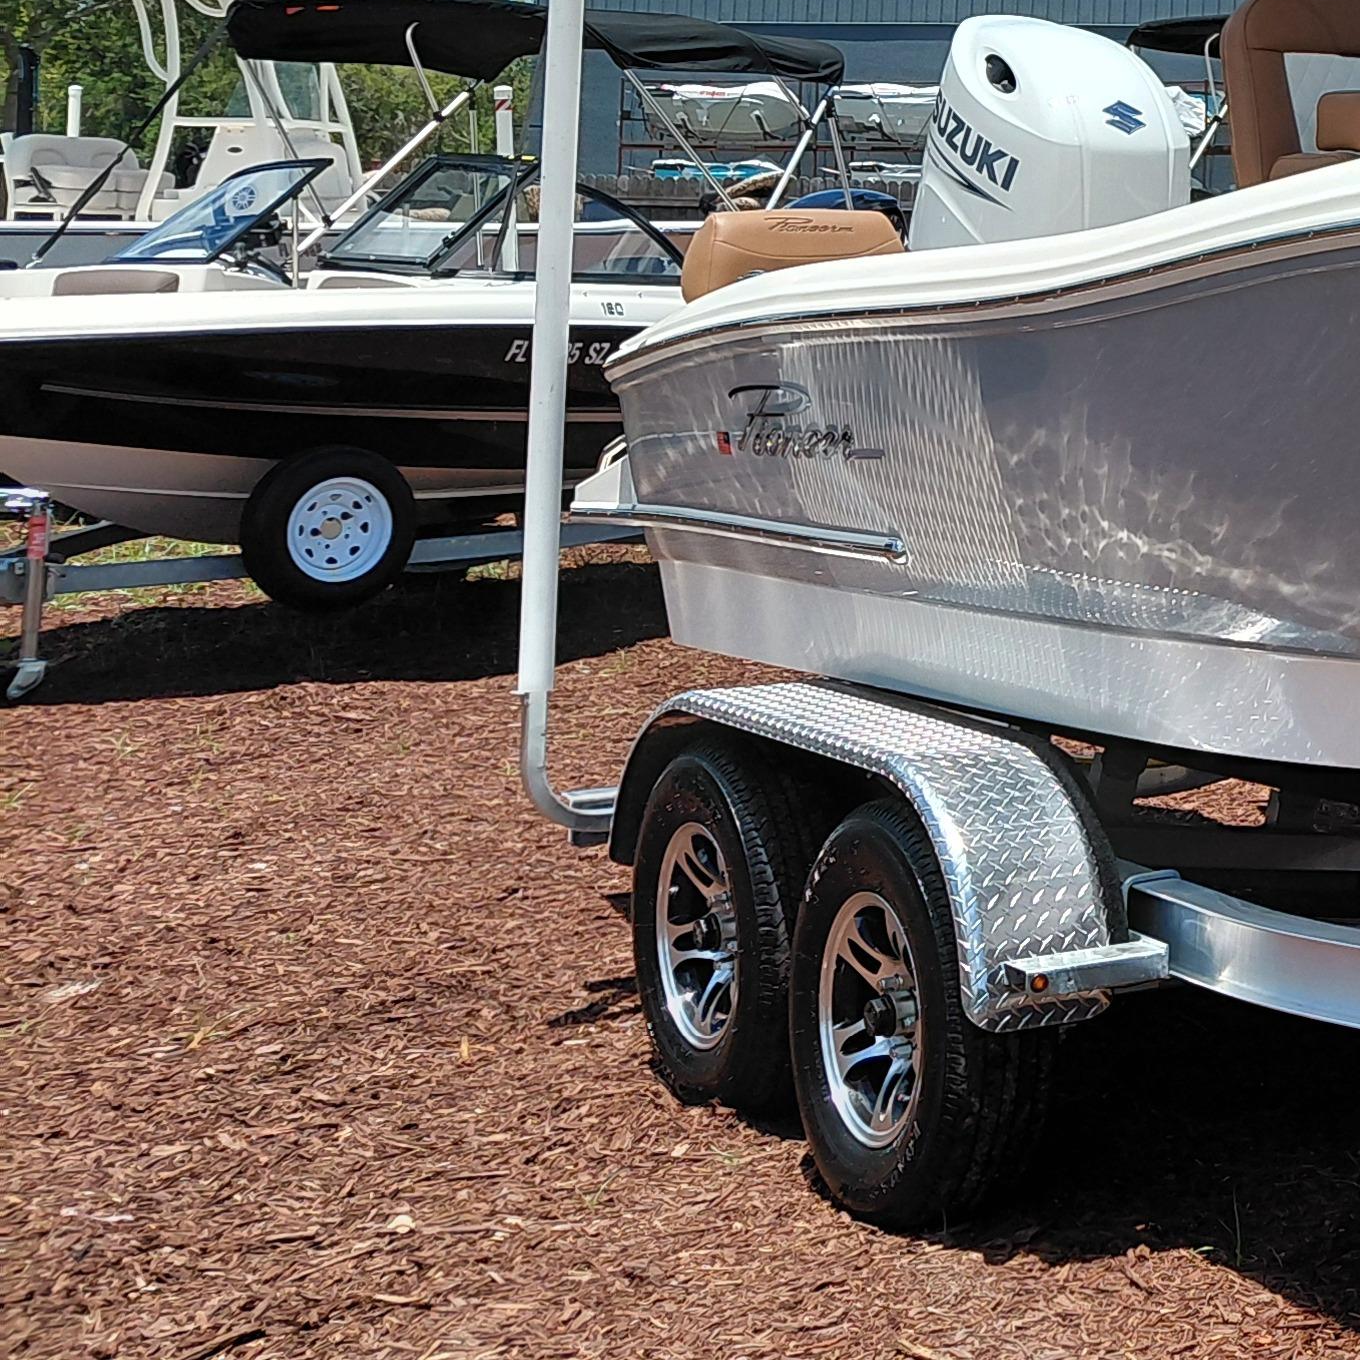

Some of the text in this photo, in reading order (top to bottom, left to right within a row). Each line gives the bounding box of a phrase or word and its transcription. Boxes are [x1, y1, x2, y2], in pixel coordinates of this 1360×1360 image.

[932, 88, 1020, 192] SUZUKI
[763, 216, 838, 233] Pioneer
[504, 339, 529, 362] FL
[584, 342, 611, 365] SZ
[727, 381, 854, 461] Pioneer
